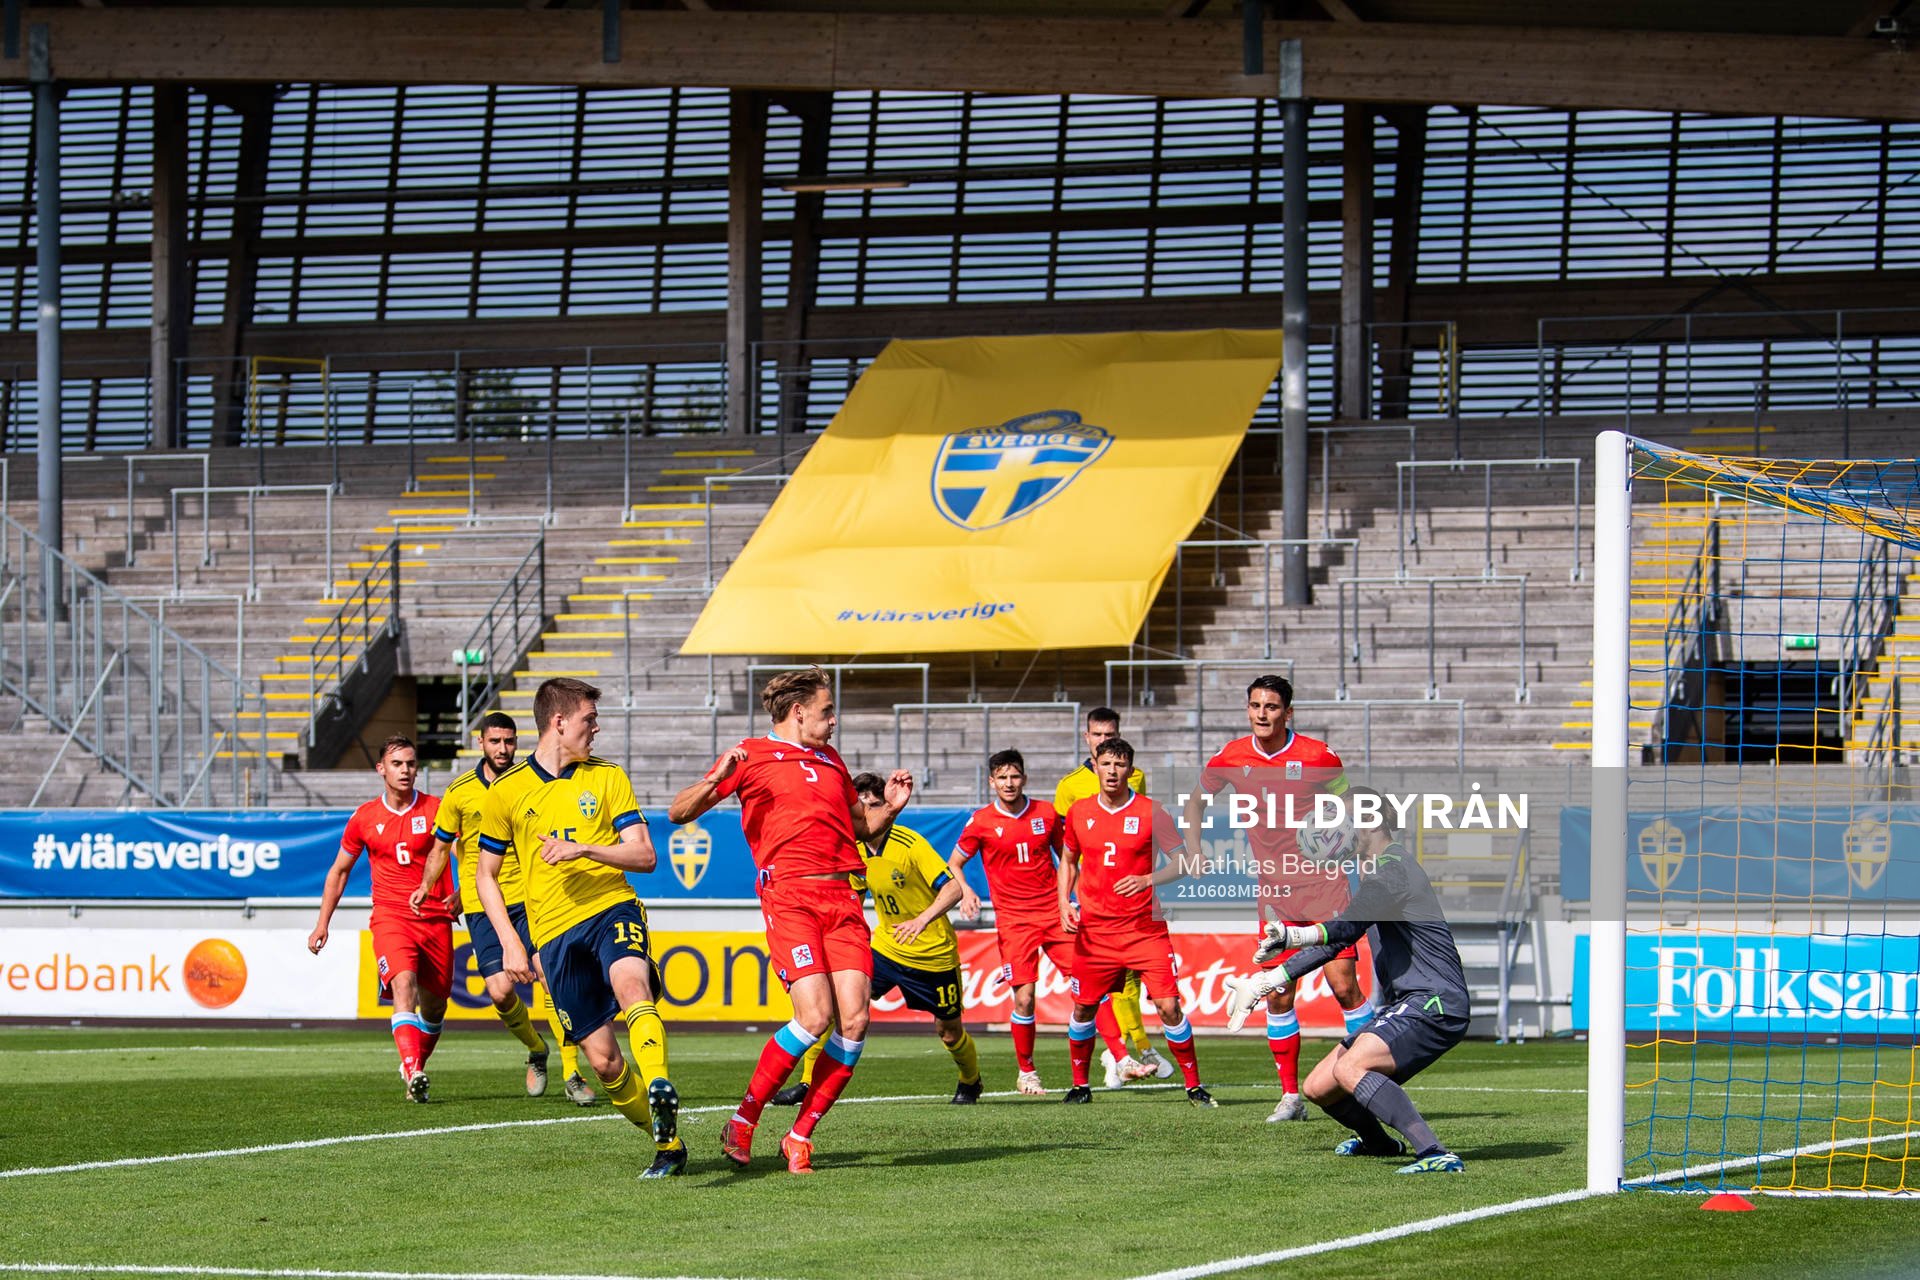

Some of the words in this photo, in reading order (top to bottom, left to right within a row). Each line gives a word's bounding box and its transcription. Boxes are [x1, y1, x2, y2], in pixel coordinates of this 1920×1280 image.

[967, 433, 1085, 449] SVERIGE
[836, 601, 1015, 623] #viärsverige
[799, 759, 818, 782] 5
[32, 833, 280, 877] #viärsverige
[395, 841, 411, 866] 6
[1015, 842, 1029, 864] 11
[1103, 841, 1116, 867] 2
[878, 894, 900, 915] 18
[614, 922, 644, 944] 15
[0, 953, 171, 993] edbank
[936, 983, 958, 1008] 18
